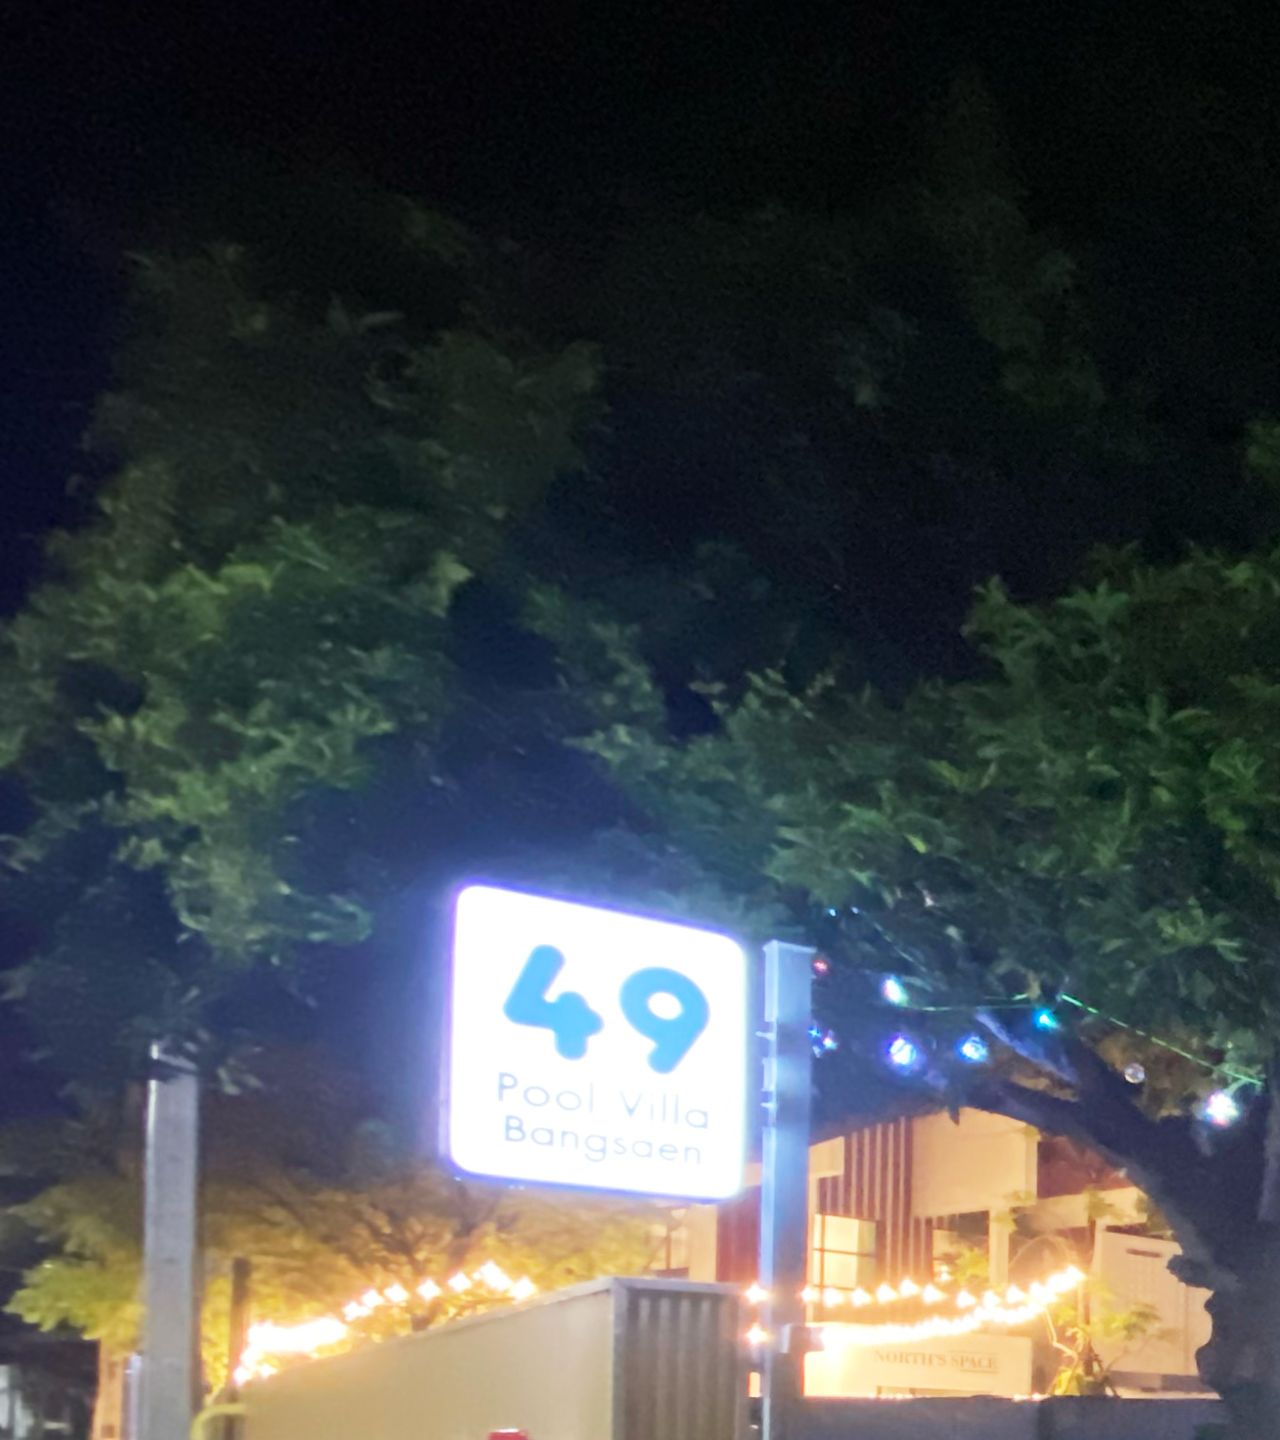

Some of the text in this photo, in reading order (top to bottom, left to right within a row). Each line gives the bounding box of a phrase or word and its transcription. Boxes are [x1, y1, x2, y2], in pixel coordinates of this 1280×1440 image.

[503, 944, 710, 1075] 49
[497, 1071, 709, 1129] Pool Villa
[503, 1114, 702, 1163] Bangsaen
[951, 1353, 999, 1370] SPACE
